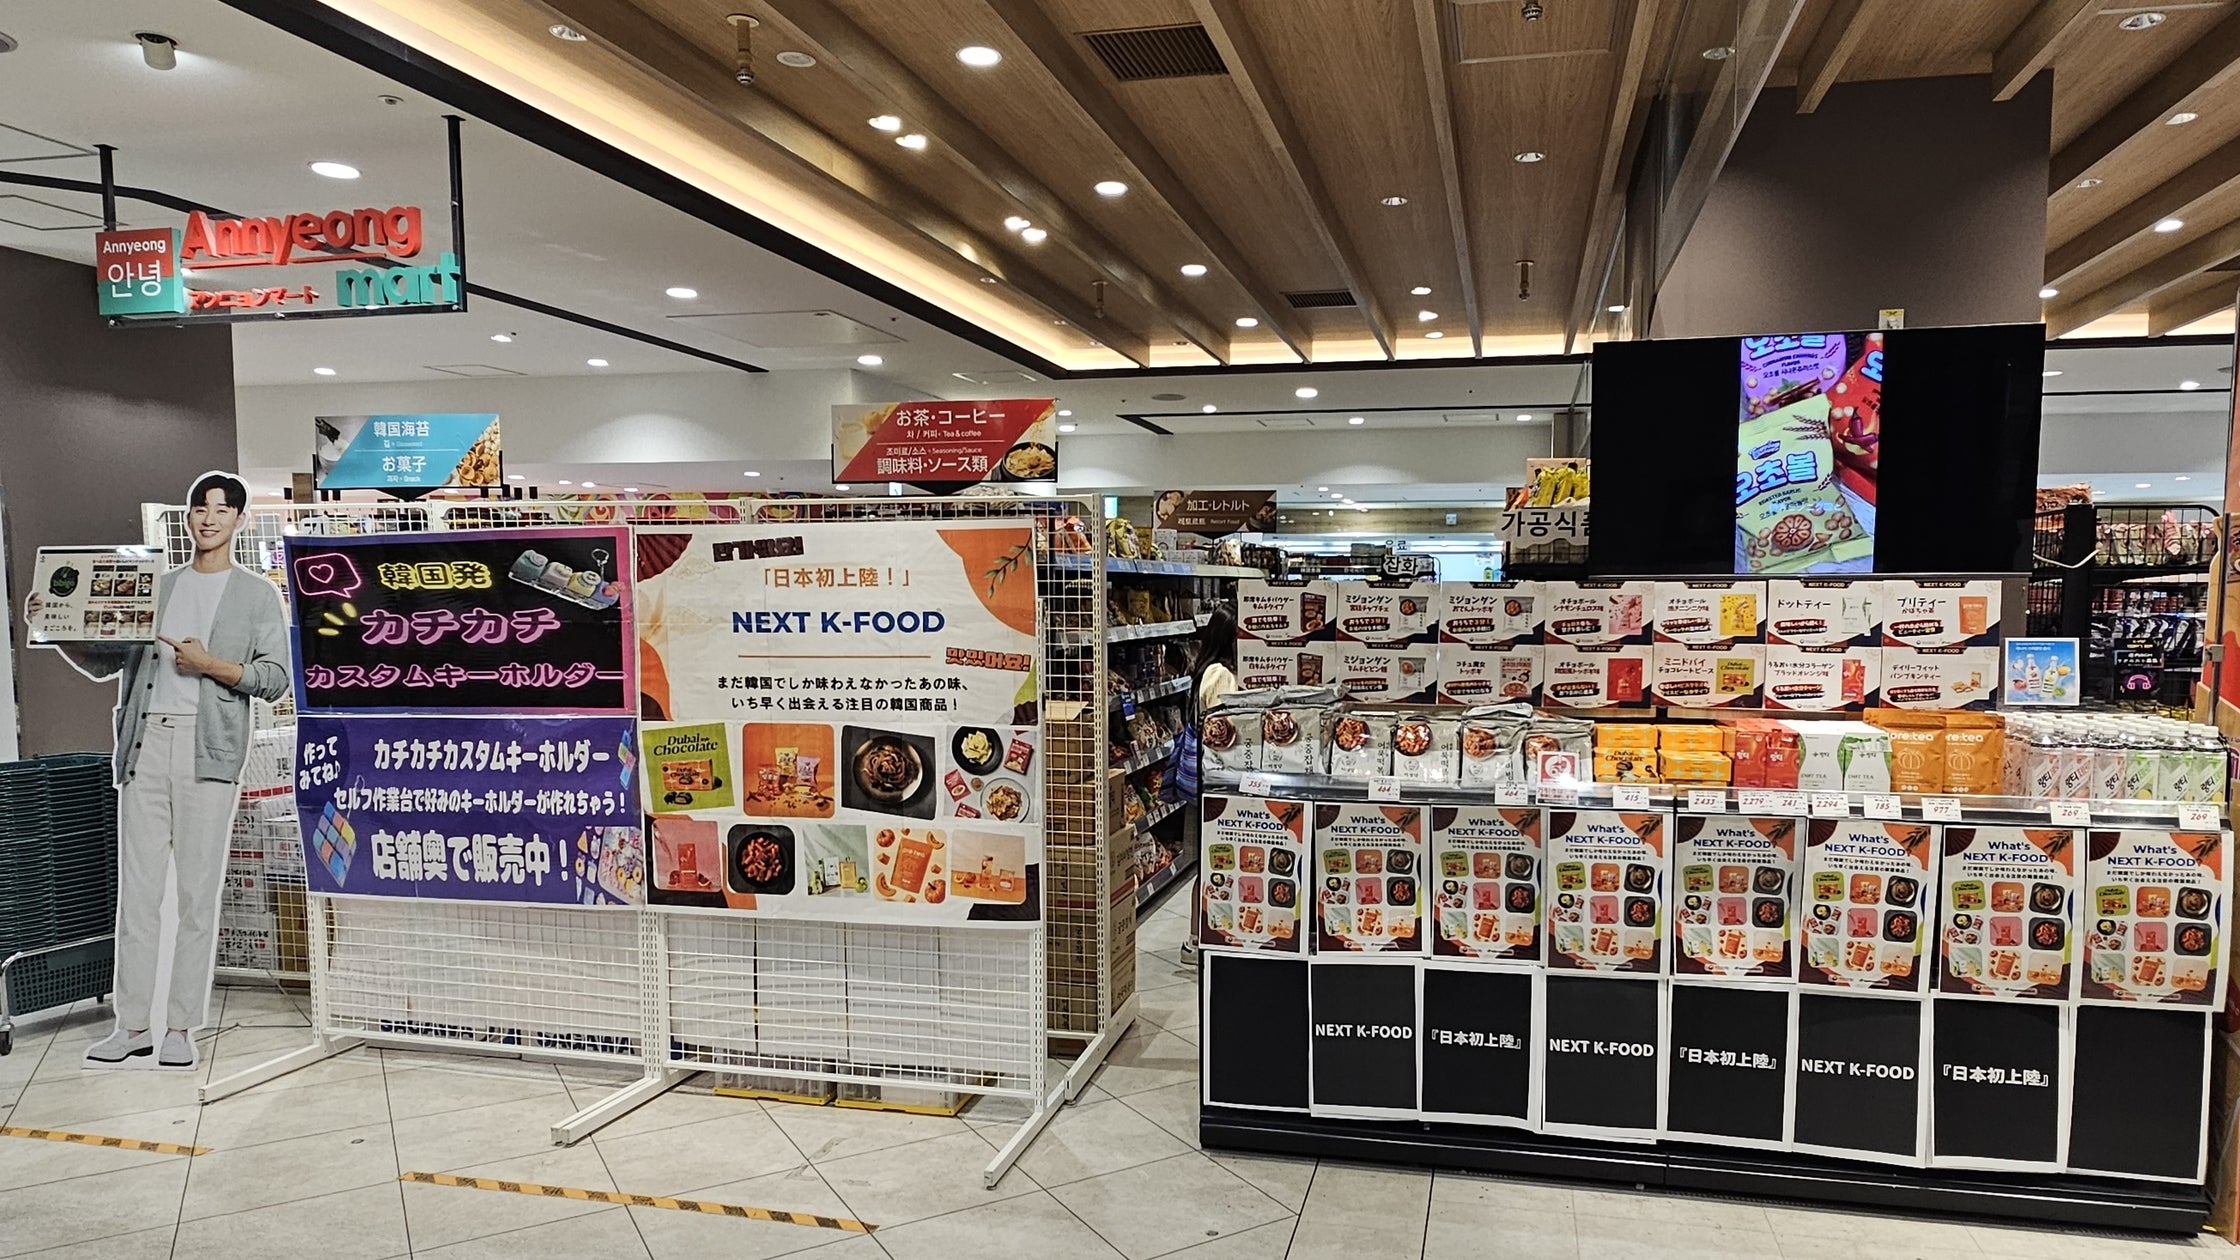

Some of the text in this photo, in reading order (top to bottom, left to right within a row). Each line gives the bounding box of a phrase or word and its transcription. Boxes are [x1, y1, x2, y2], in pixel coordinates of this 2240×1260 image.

[180, 205, 422, 265] Annyeong
[103, 238, 166, 256] Annyeong
[107, 259, 162, 298] 안녕
[335, 252, 460, 307] mart
[373, 421, 430, 437] 韓国海苔
[886, 446, 927, 456] 조미료/소스
[382, 456, 427, 473] お菓子
[1385, 556, 1418, 575] 잡화
[380, 562, 493, 590] 韓国発
[1777, 599, 1832, 610] ドットティー
[360, 607, 561, 645] カチカチ
[733, 611, 945, 634] NEXT K-FOOD
[945, 647, 1031, 672] 맛있어요!
[305, 664, 627, 688] カスタムキーホルダー
[717, 676, 969, 691] まだ韓国でしか味わえなかったあの味、
[668, 732, 700, 746] Dubai
[304, 736, 338, 766] 作って
[374, 738, 610, 773] カチカチカスタムキーホルダー
[653, 741, 719, 756] Chocolate
[1236, 810, 1270, 819] What's
[1933, 806, 1949, 814] 977
[1217, 819, 1243, 828] NEXT
[1350, 815, 1386, 825] What's
[1468, 818, 1505, 827] What's
[1331, 825, 1358, 833] NEXT
[1448, 828, 1476, 836] NEXT
[1587, 824, 1625, 834] What's
[1716, 829, 1756, 838] What's
[1566, 835, 1595, 844] NEXT
[1693, 839, 1723, 847] NEXT
[1848, 834, 1890, 844] What's
[1988, 841, 2031, 851] What's
[1824, 843, 1855, 854] NEXT
[2133, 844, 2178, 855] What's
[371, 829, 569, 886] 店舗奥で販売中！
[1963, 853, 1996, 861] NEXT
[2107, 856, 2141, 866] NEXT
[1315, 1024, 1413, 1040] NEXT K-FOOD
[1431, 1029, 1521, 1050] 『日本初上陸』
[1549, 1038, 1655, 1057] NEXT K-FOOD
[1679, 1047, 1777, 1070] 『日本初上陸』
[1801, 1058, 1915, 1081] NEXT K-FOOD
[1942, 1064, 2050, 1088] 『日本初上陸』
